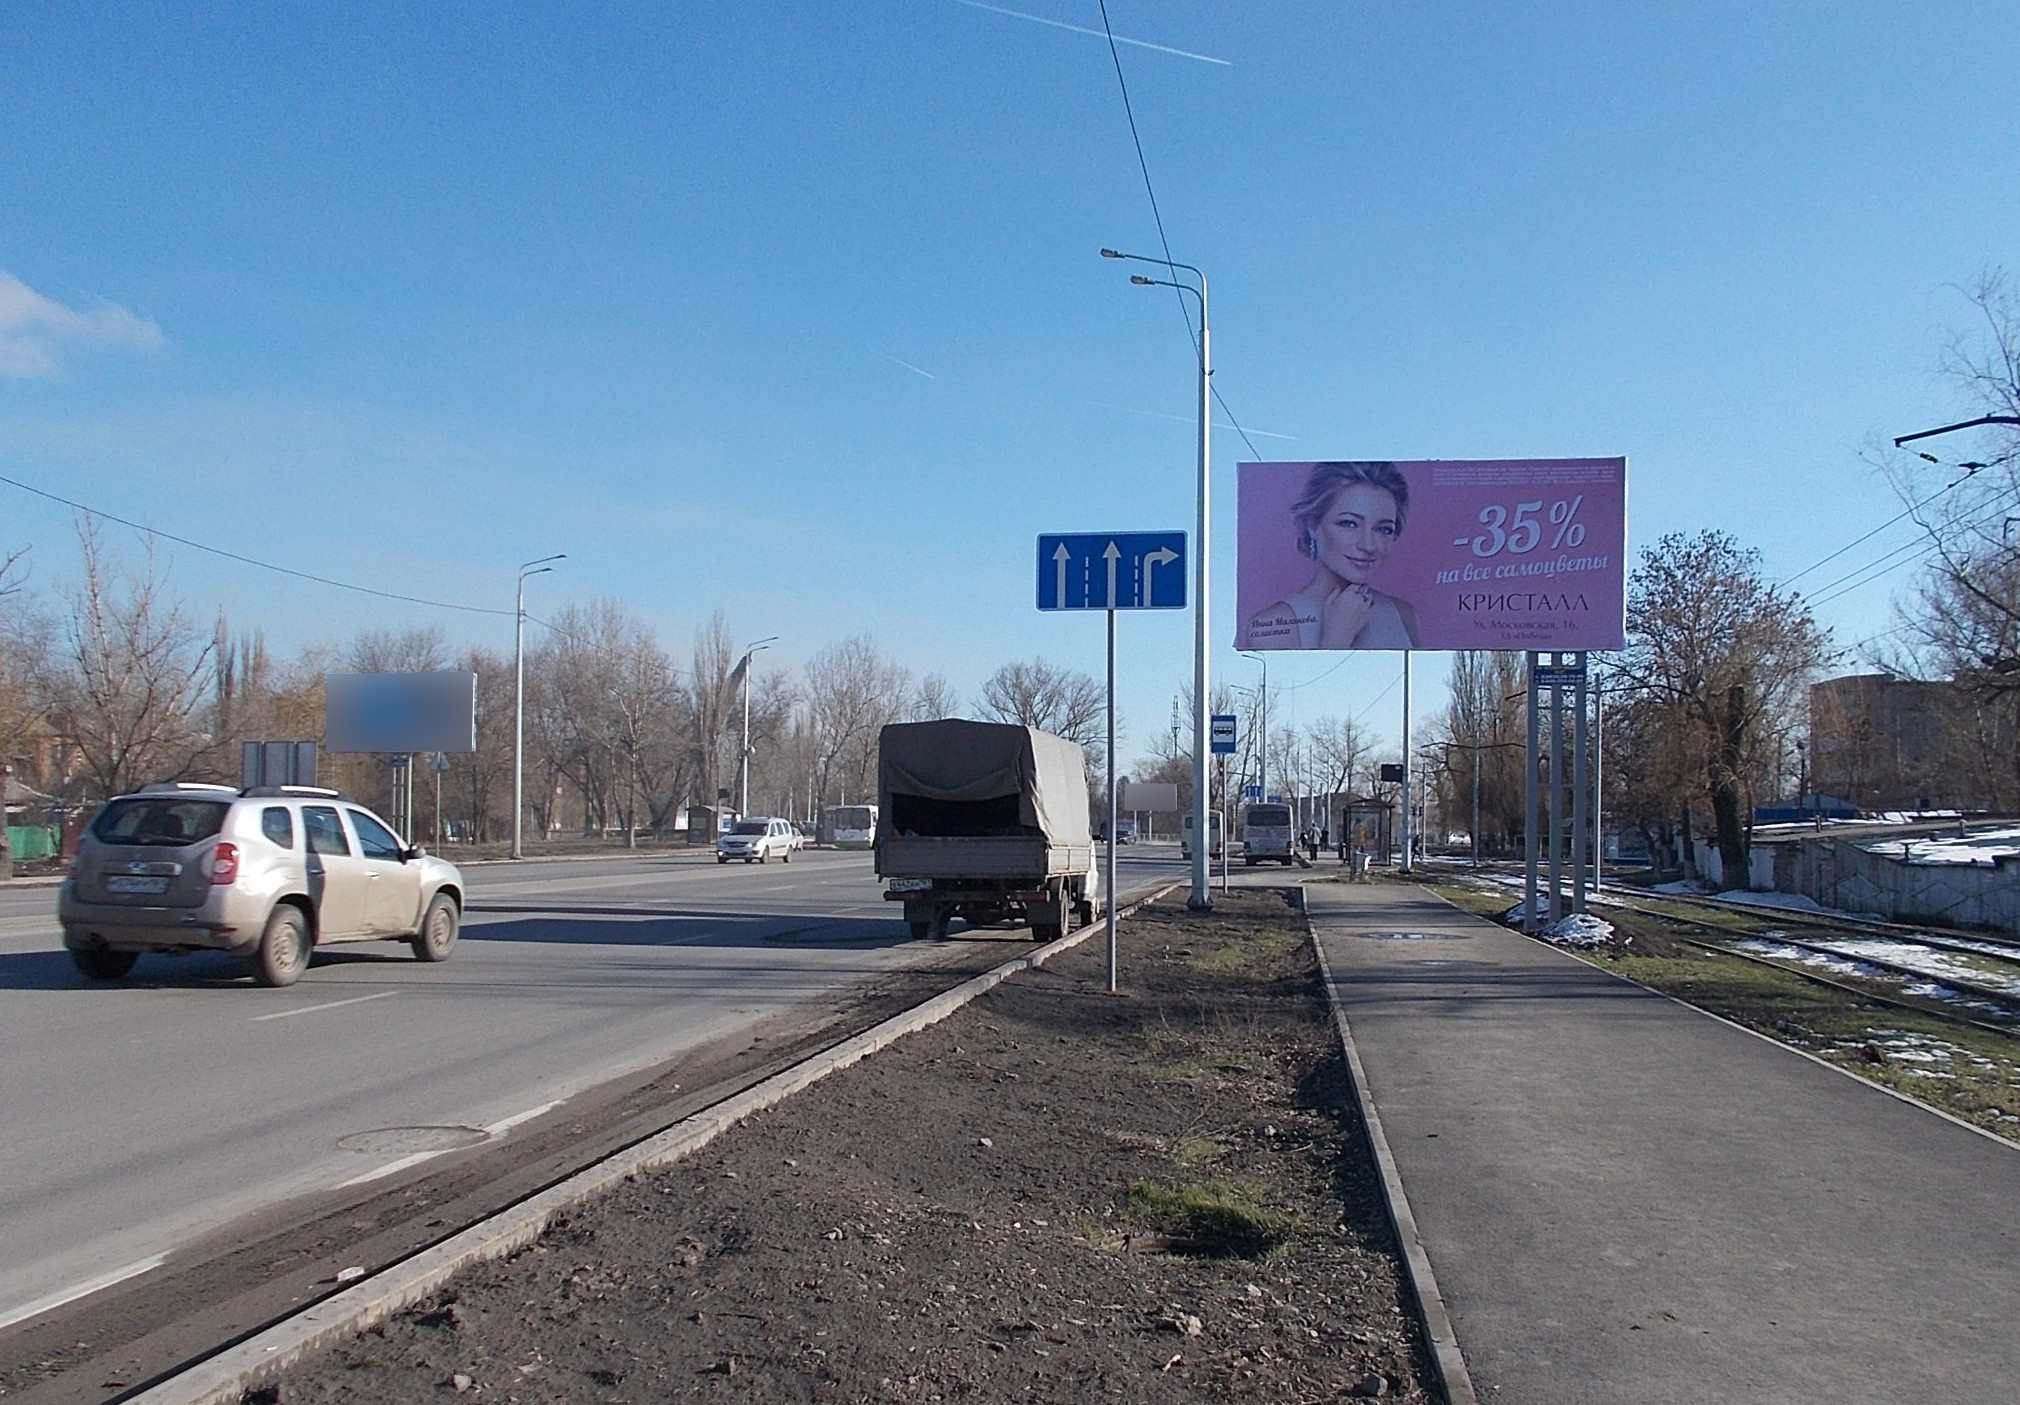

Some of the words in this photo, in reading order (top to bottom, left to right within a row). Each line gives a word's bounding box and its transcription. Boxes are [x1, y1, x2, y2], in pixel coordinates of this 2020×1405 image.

[1453, 495, 1586, 558] -35%
[1435, 569, 1459, 585] на
[1464, 563, 1492, 582] все
[1495, 554, 1609, 579] самоцветы
[1458, 593, 1589, 612] КРИСТАЛЛ
